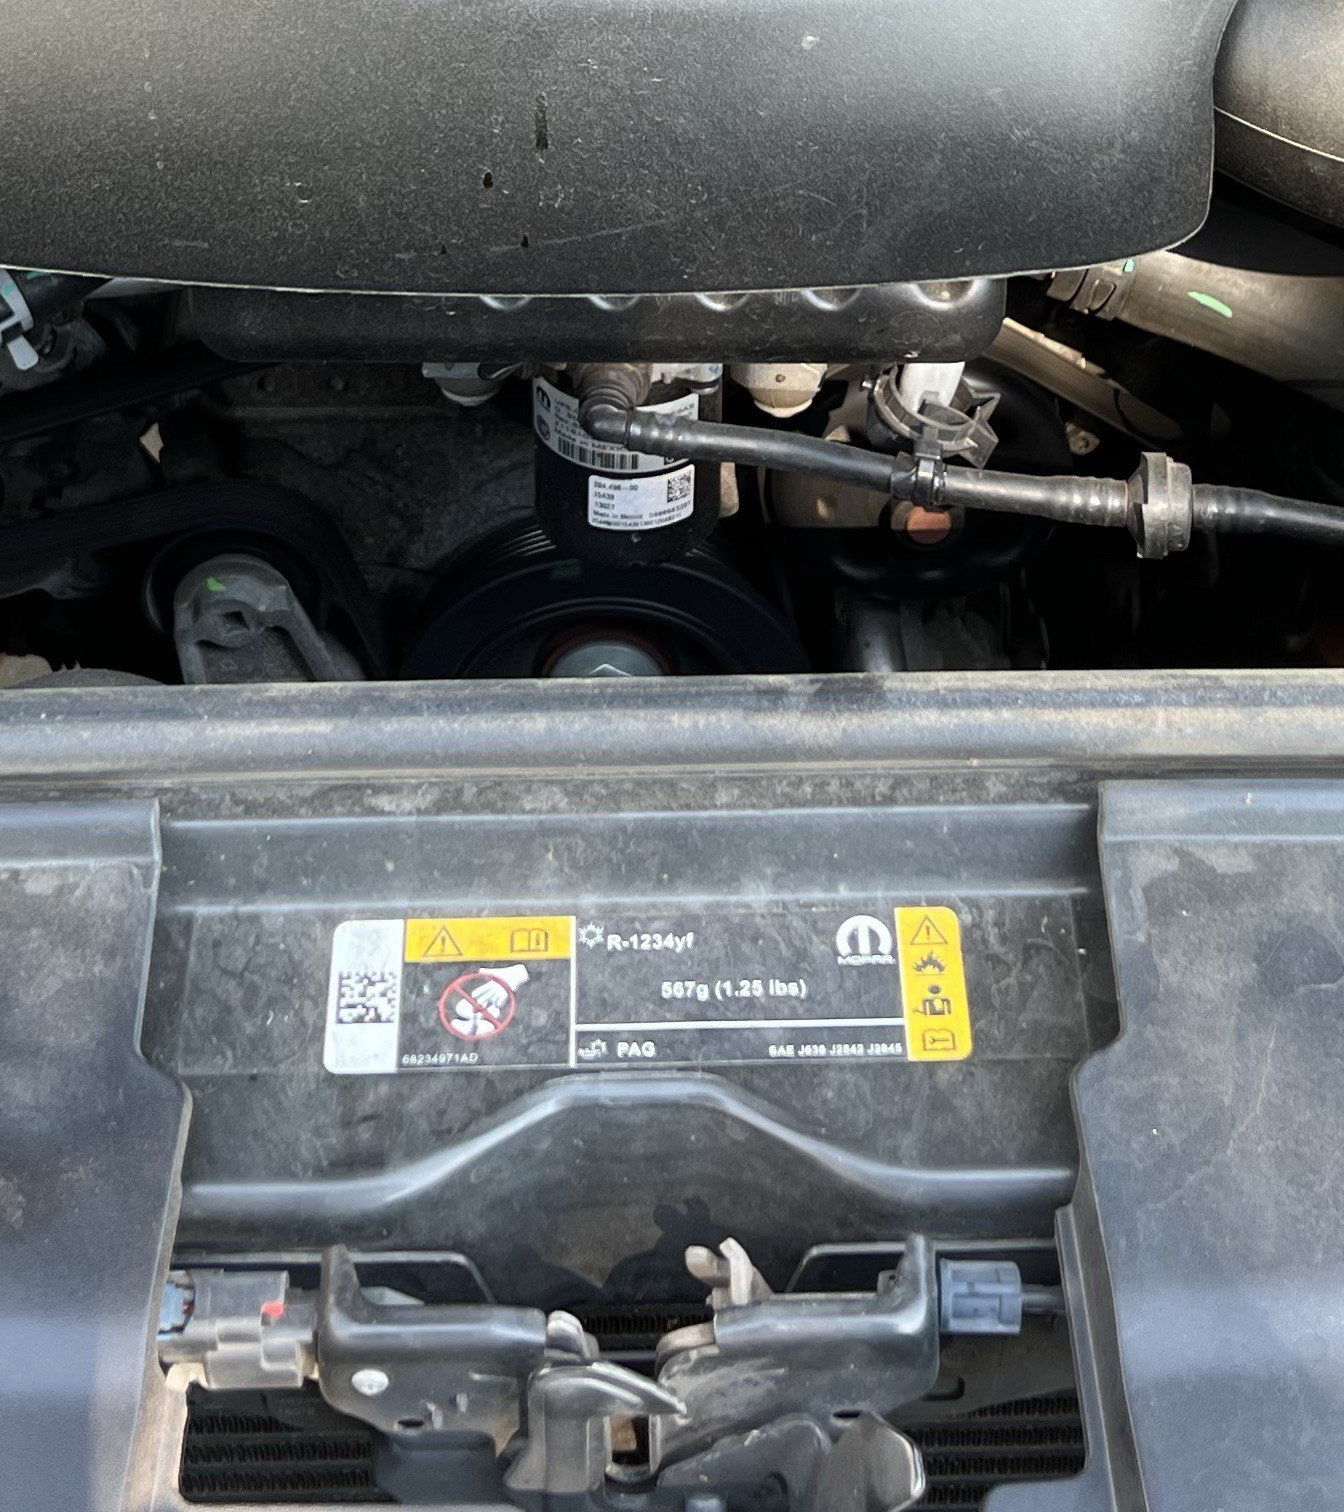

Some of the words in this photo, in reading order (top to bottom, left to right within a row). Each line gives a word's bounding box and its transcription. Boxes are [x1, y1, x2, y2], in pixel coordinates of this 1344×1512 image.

[607, 931, 695, 953] R-1234yf
[661, 980, 709, 1002] 567g
[714, 979, 764, 1001] (1.25
[769, 978, 808, 999] lbs)
[617, 1040, 656, 1058] PAG
[768, 1044, 794, 1057] SAE
